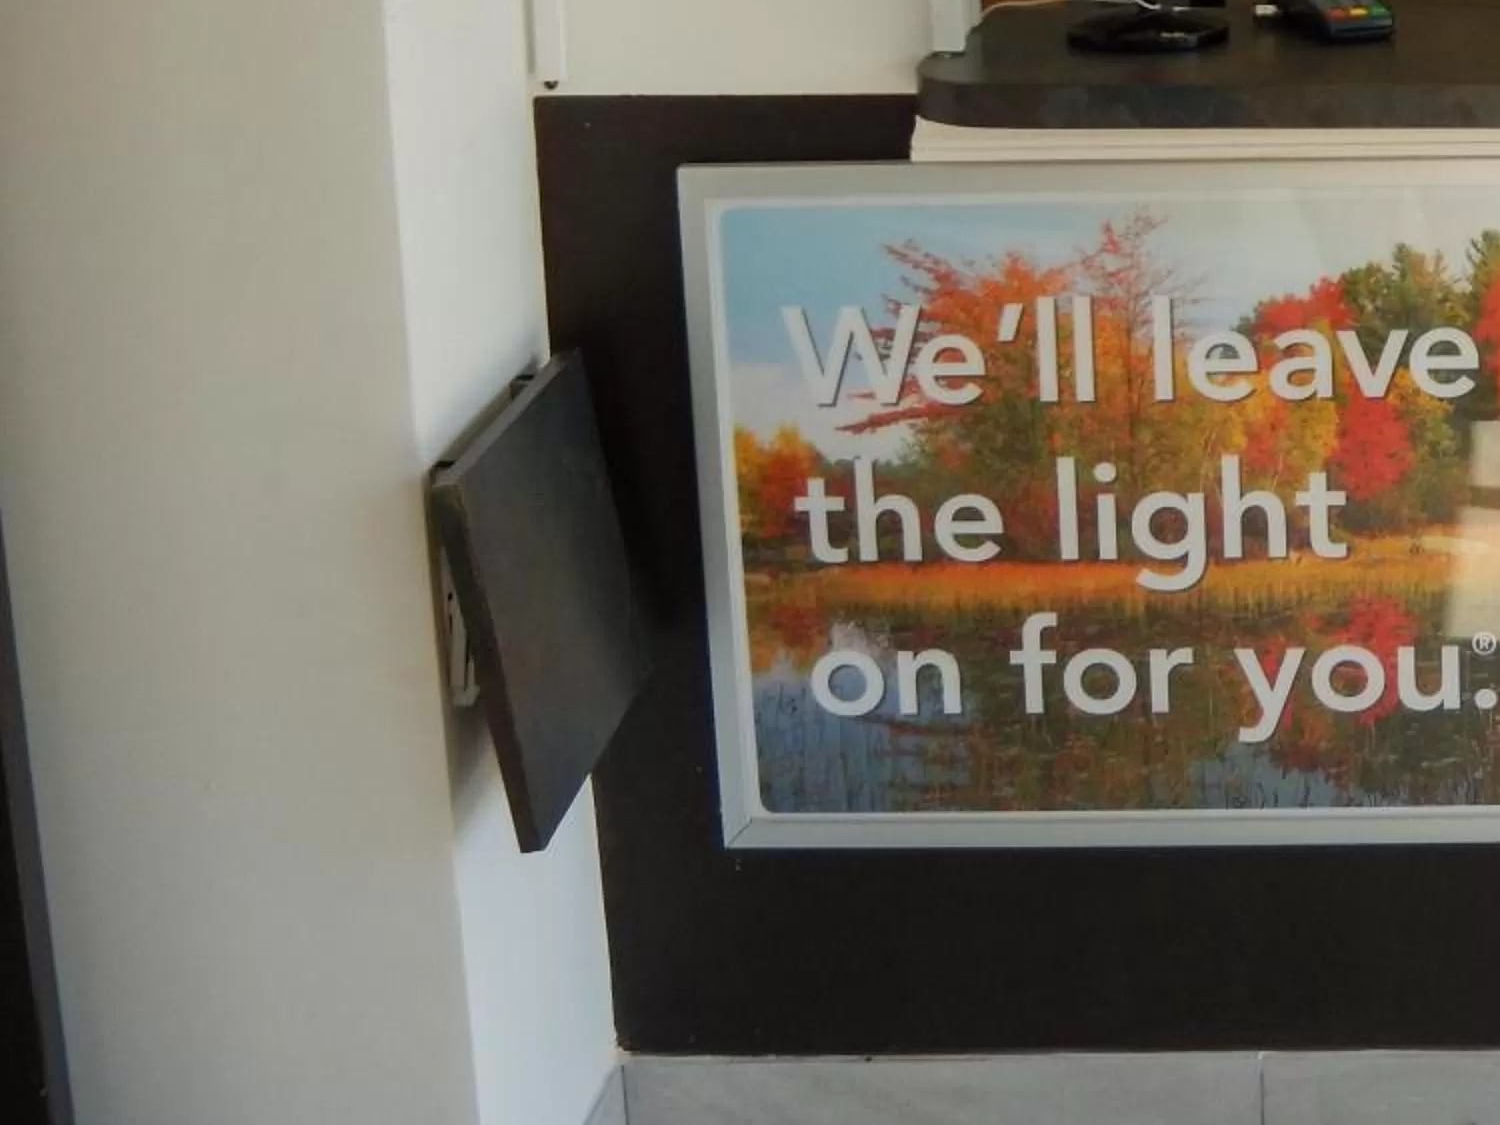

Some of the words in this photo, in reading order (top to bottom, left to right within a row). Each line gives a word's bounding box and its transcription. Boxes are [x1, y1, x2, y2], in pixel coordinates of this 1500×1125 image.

[780, 293, 1096, 407] We'll
[1152, 293, 1481, 403] leave
[794, 456, 1004, 565] the
[1056, 454, 1348, 592] light
[810, 645, 963, 716] on
[1009, 612, 1196, 715] for
